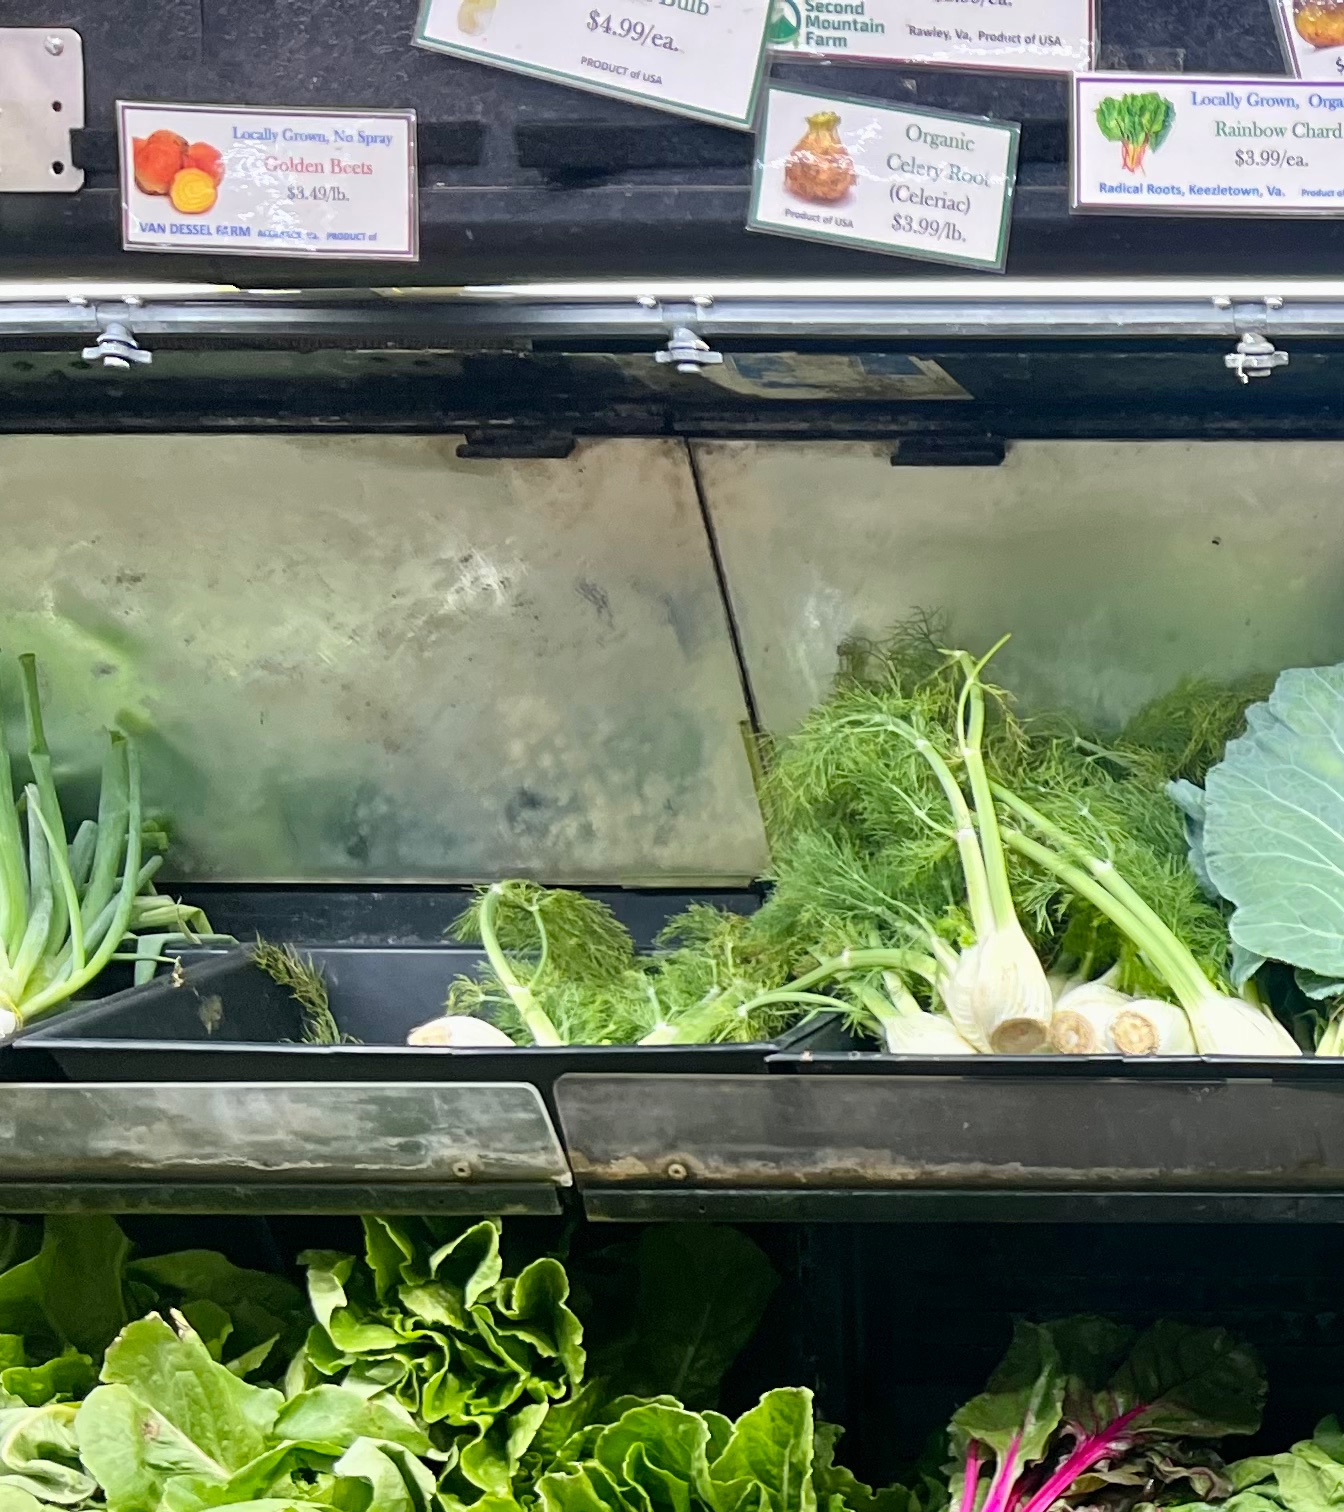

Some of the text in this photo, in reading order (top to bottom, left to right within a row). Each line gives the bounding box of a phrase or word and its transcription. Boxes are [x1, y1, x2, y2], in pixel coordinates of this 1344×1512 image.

[804, 0, 865, 15] Second
[587, 9, 679, 51] $4.99/ea.
[805, 14, 885, 34] Mountain
[806, 31, 847, 48] Farm
[978, 31, 1021, 44] Product
[1024, 34, 1036, 44] of
[1039, 35, 1062, 47] USA
[580, 56, 663, 85] PRODUCT of USA
[1191, 91, 1242, 109] Locally
[1247, 92, 1300, 110] Grown,
[232, 126, 393, 147] Locally Grown, No Spray
[905, 123, 975, 152] Organic
[1215, 120, 1343, 139] Rainbow Chard
[264, 156, 373, 175] Golden Beets
[886, 153, 944, 181] Celery
[1235, 149, 1309, 169] $3.99/ea.
[287, 184, 350, 202] $3.49/lb.
[1099, 182, 1143, 195] Radical
[1147, 184, 1185, 197] Roots,
[1301, 188, 1334, 197] Product
[889, 183, 971, 216] (Celeriac)
[785, 208, 854, 229] Product of USA
[892, 212, 967, 243] $3.99/lb.
[139, 222, 166, 234] VAN
[170, 223, 212, 235] DESSEL
[326, 232, 366, 241] PRODUCT
